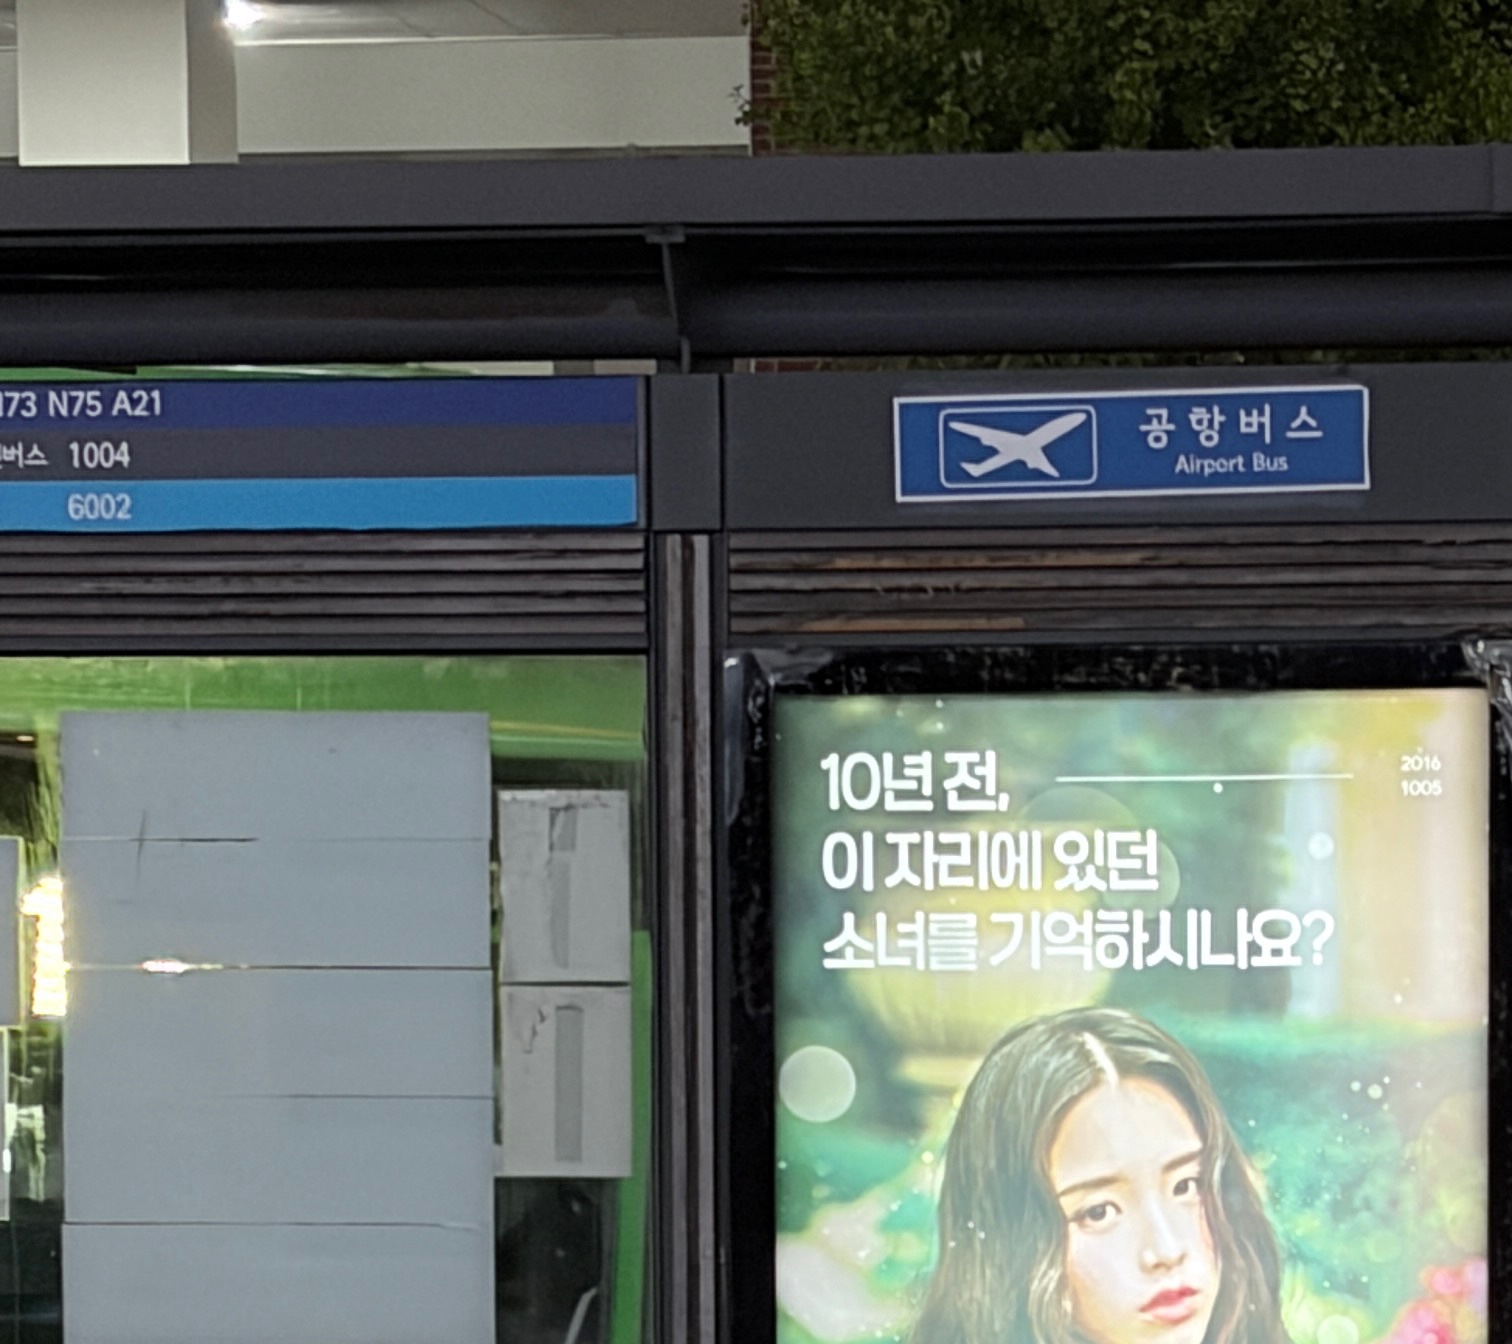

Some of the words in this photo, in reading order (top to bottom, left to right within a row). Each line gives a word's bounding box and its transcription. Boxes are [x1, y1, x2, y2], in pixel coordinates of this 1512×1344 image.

[0, 390, 38, 418] 73
[48, 390, 103, 418] N75
[111, 389, 161, 416] A21
[1138, 402, 1323, 449] 공항버스
[0, 441, 49, 469] 버스
[69, 441, 130, 469] 1004
[1175, 453, 1246, 477] Airport
[1252, 451, 1289, 472] Bus
[67, 492, 132, 521] 6002
[1400, 754, 1442, 772] 2016
[820, 749, 934, 812] 10년
[943, 749, 1010, 812] 전,
[1401, 779, 1443, 797] 1005
[822, 830, 874, 892] 이
[884, 829, 1042, 891] 자리에
[1053, 828, 1159, 893] 있던
[822, 910, 979, 972] 소녀를
[989, 907, 1336, 972] 기억하시나요?
